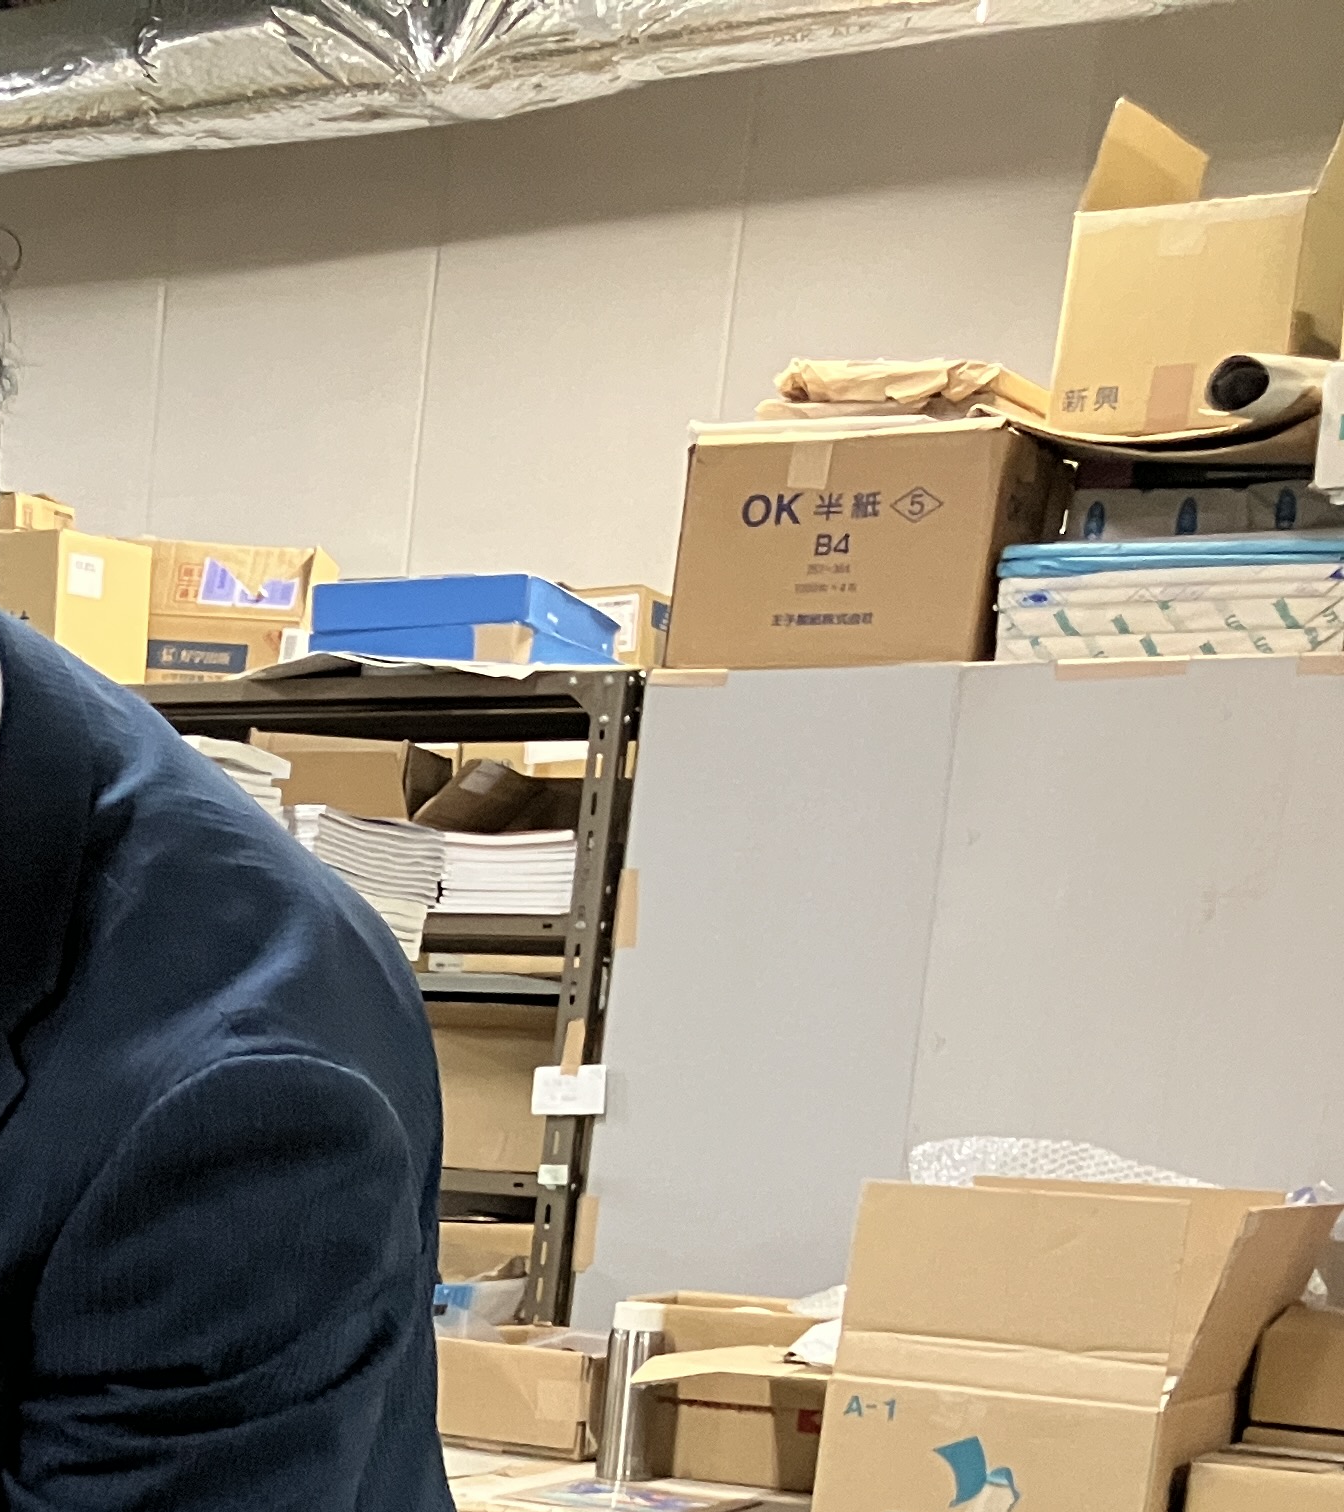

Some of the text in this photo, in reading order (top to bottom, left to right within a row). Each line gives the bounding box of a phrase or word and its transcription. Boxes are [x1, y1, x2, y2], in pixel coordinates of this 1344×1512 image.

[1063, 386, 1119, 412] 新興
[742, 491, 925, 527] OK 半紙 5
[814, 532, 850, 556] B4
[844, 1395, 897, 1421] A-1
